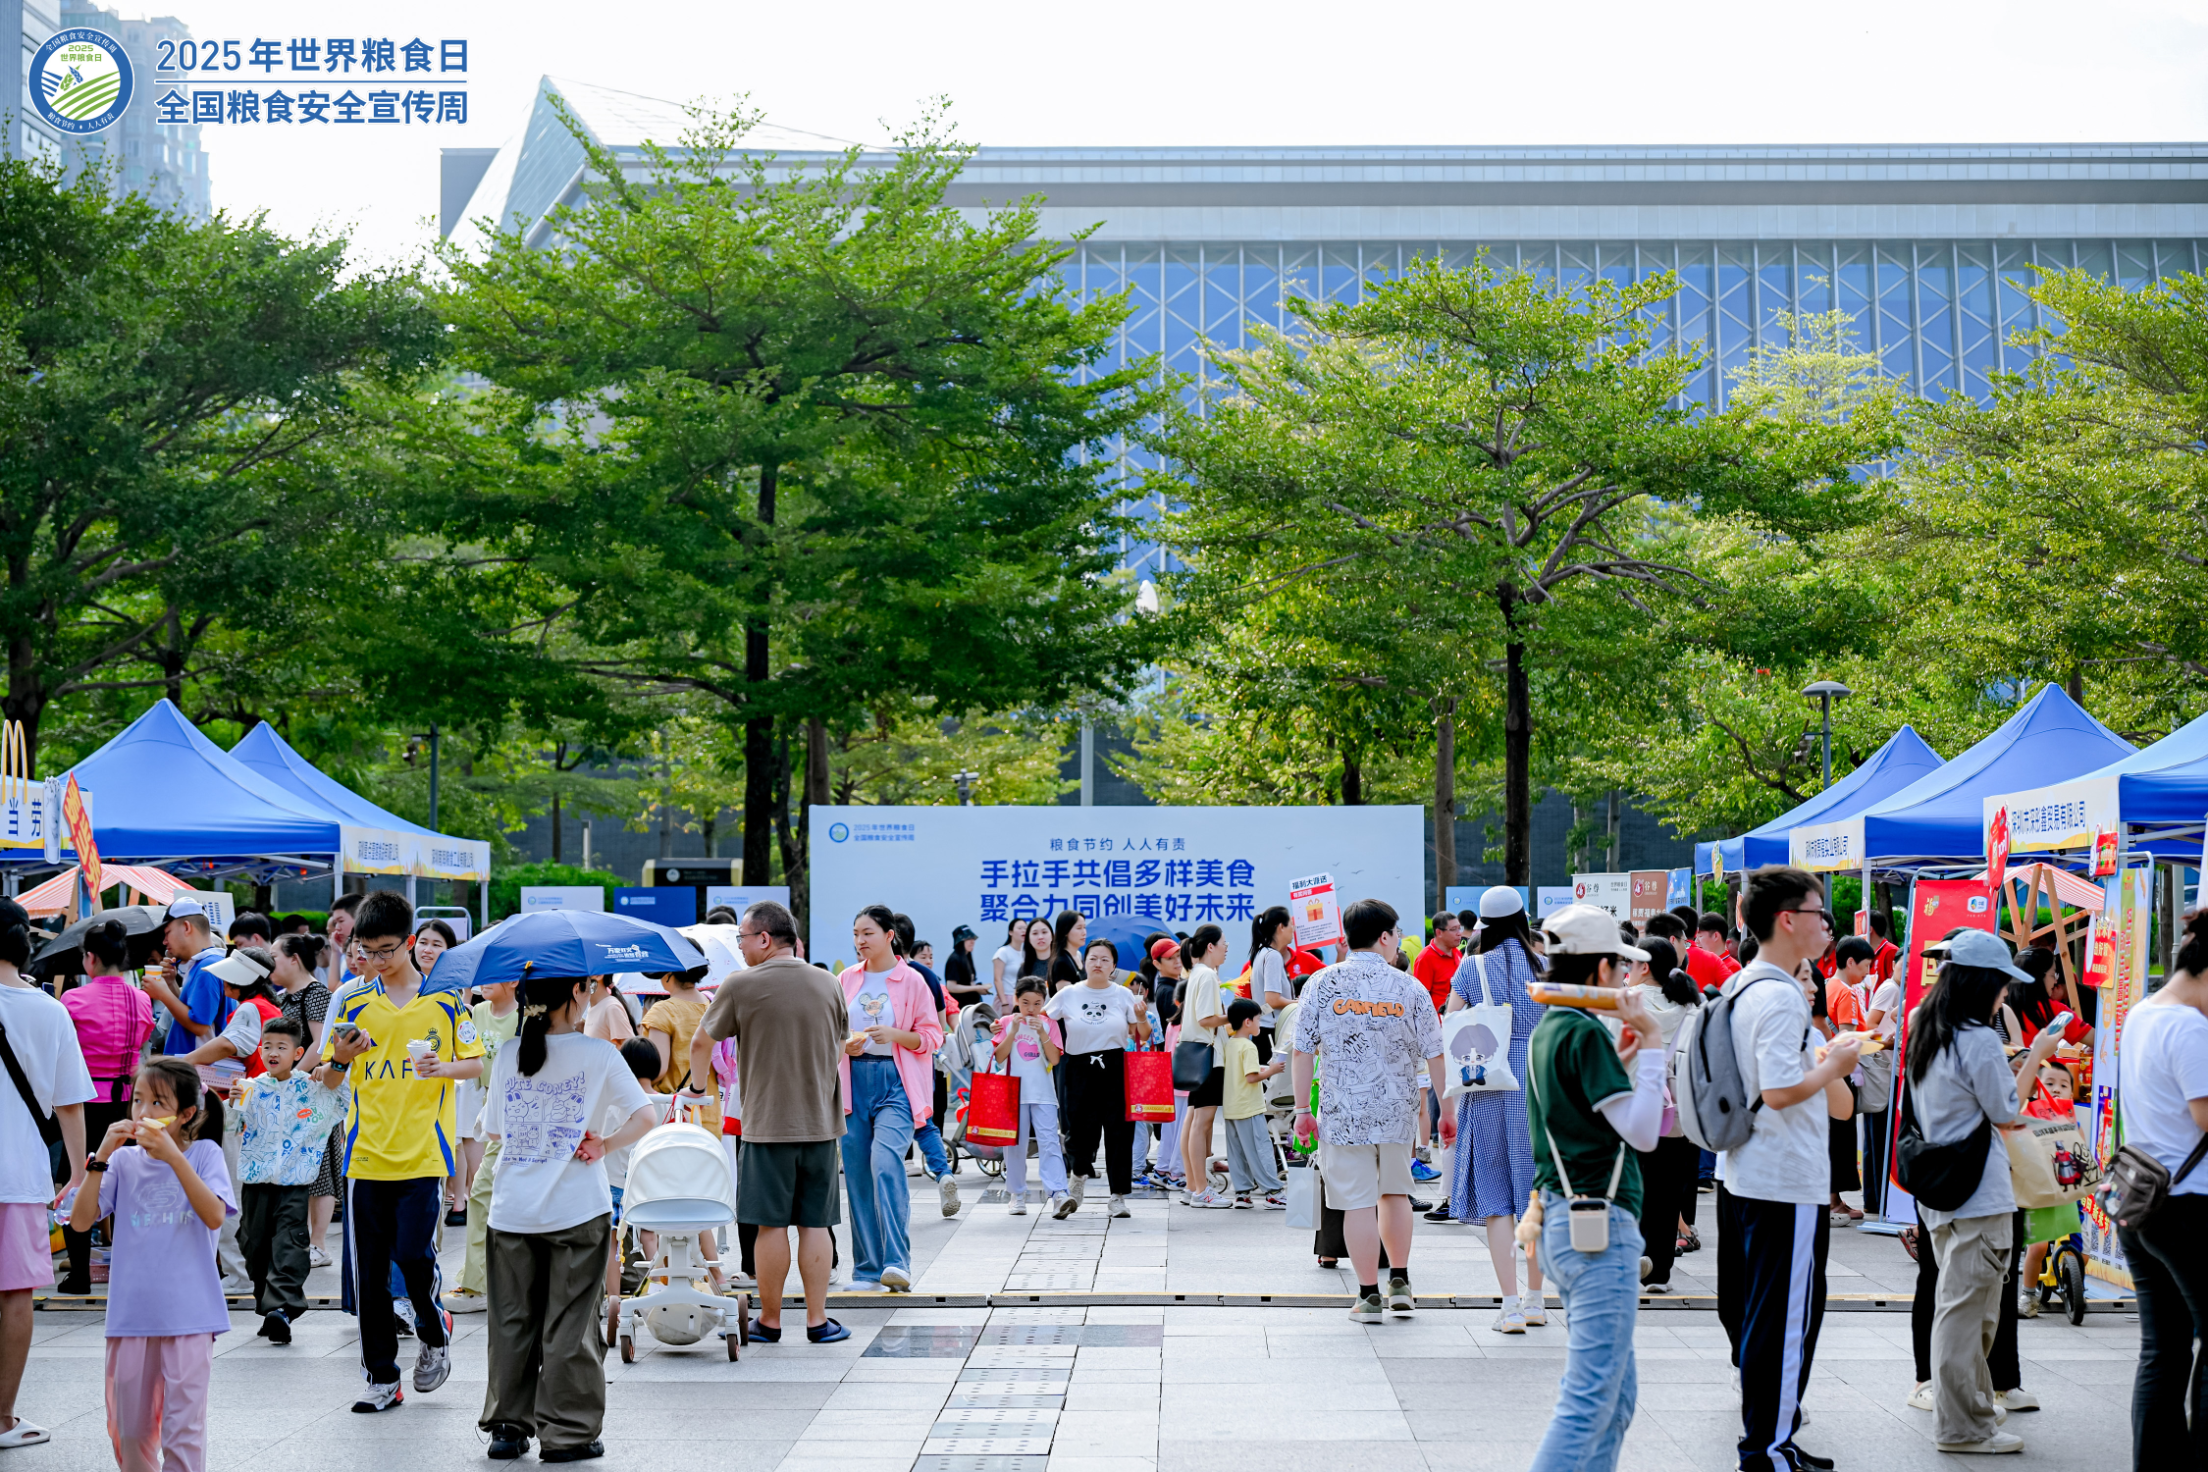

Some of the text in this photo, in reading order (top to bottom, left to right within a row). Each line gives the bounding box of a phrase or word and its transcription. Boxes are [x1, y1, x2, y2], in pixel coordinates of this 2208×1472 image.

[1050, 838, 1186, 851] 粮食节约 人人有责
[980, 859, 1255, 888] 手拉手共倡多样美食
[980, 893, 1255, 922] 聚合力同创美好未来
[1333, 999, 1405, 1018] GARFIELD
